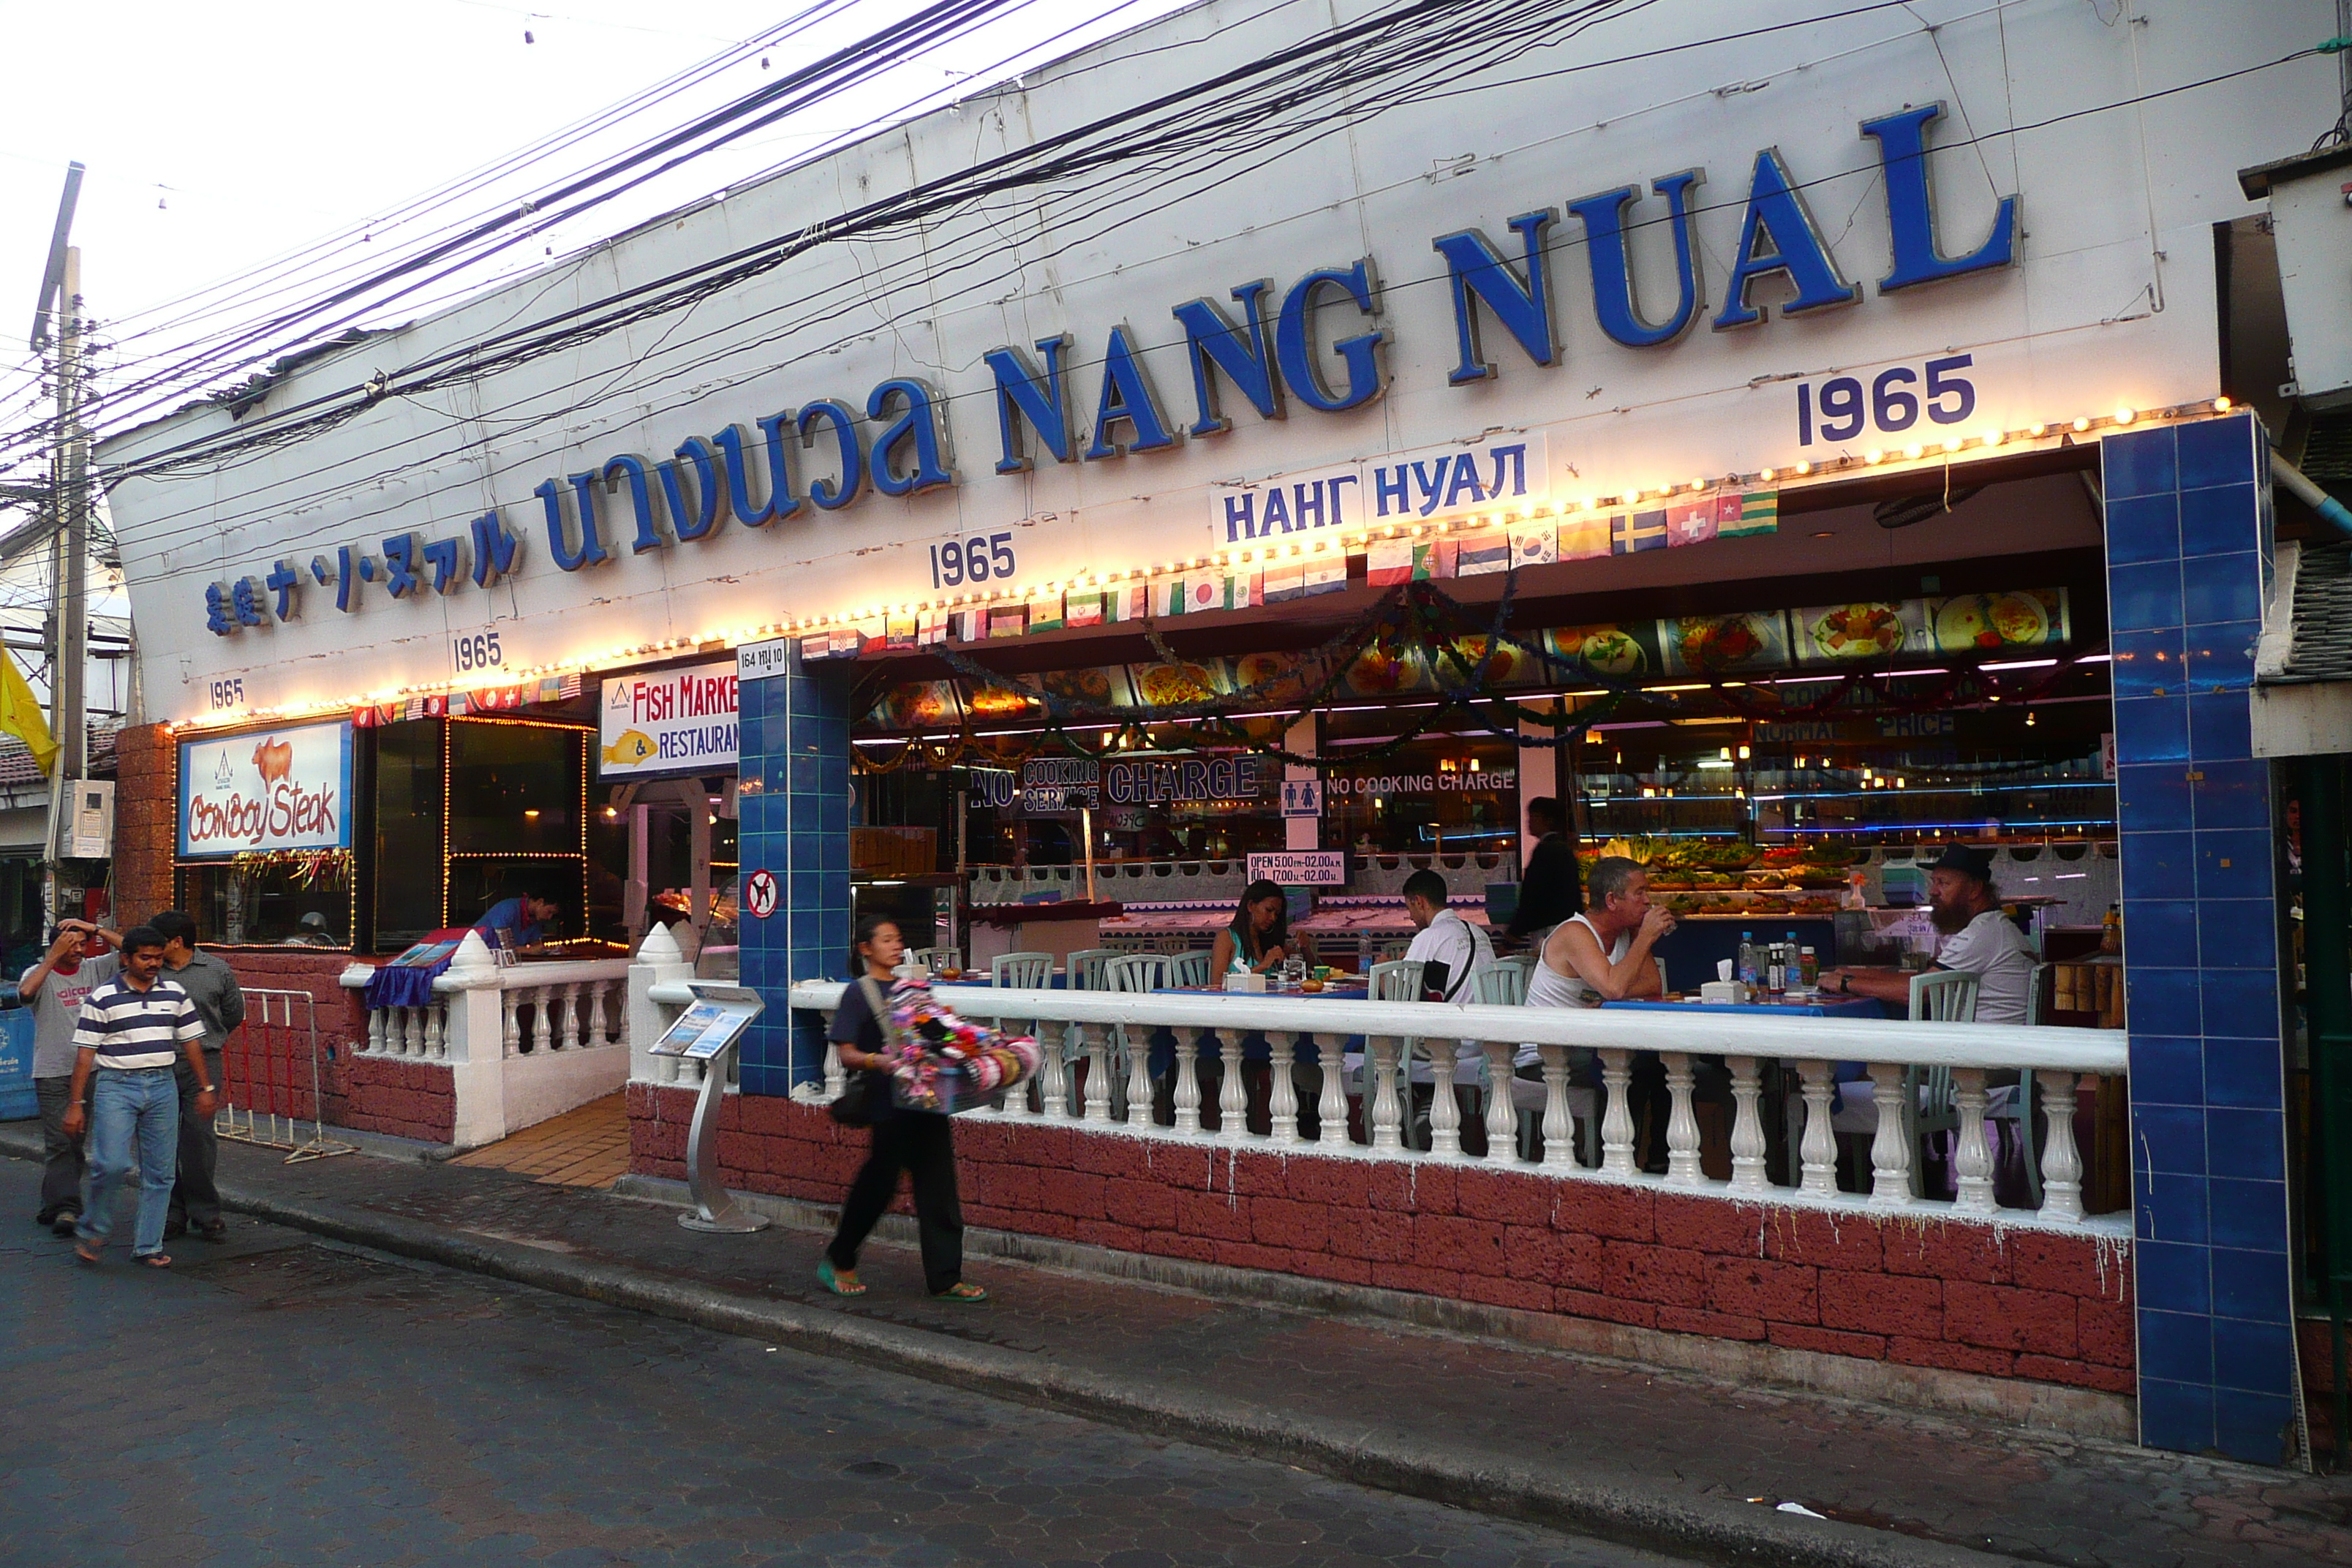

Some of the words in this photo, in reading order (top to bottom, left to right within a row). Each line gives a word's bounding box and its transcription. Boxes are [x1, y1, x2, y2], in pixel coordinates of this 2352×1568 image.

[984, 257, 1394, 475] NANG
[1433, 100, 2024, 386] NUAL
[1798, 354, 1976, 446] 1965
[1224, 475, 1358, 543] НАНГ
[1374, 443, 1527, 518] НУАЛ
[930, 532, 1017, 589] 1965
[453, 633, 502, 672] 1965
[741, 652, 755, 668] 164
[774, 647, 783, 663] 10
[210, 678, 244, 710] 1965
[633, 682, 674, 723] FISH
[680, 675, 739, 718] MARKE
[636, 739, 647, 756] &
[660, 723, 739, 759] RESTAURAN
[1881, 715, 1956, 737] PRICE
[970, 770, 1014, 807] NO
[1024, 760, 1099, 785] COOKING
[1108, 755, 1259, 803] CHARGE
[1327, 778, 1351, 795] NO
[1354, 774, 1433, 794] COOKING
[1438, 772, 1515, 791] CHARGE
[1251, 856, 1273, 868] OPEN
